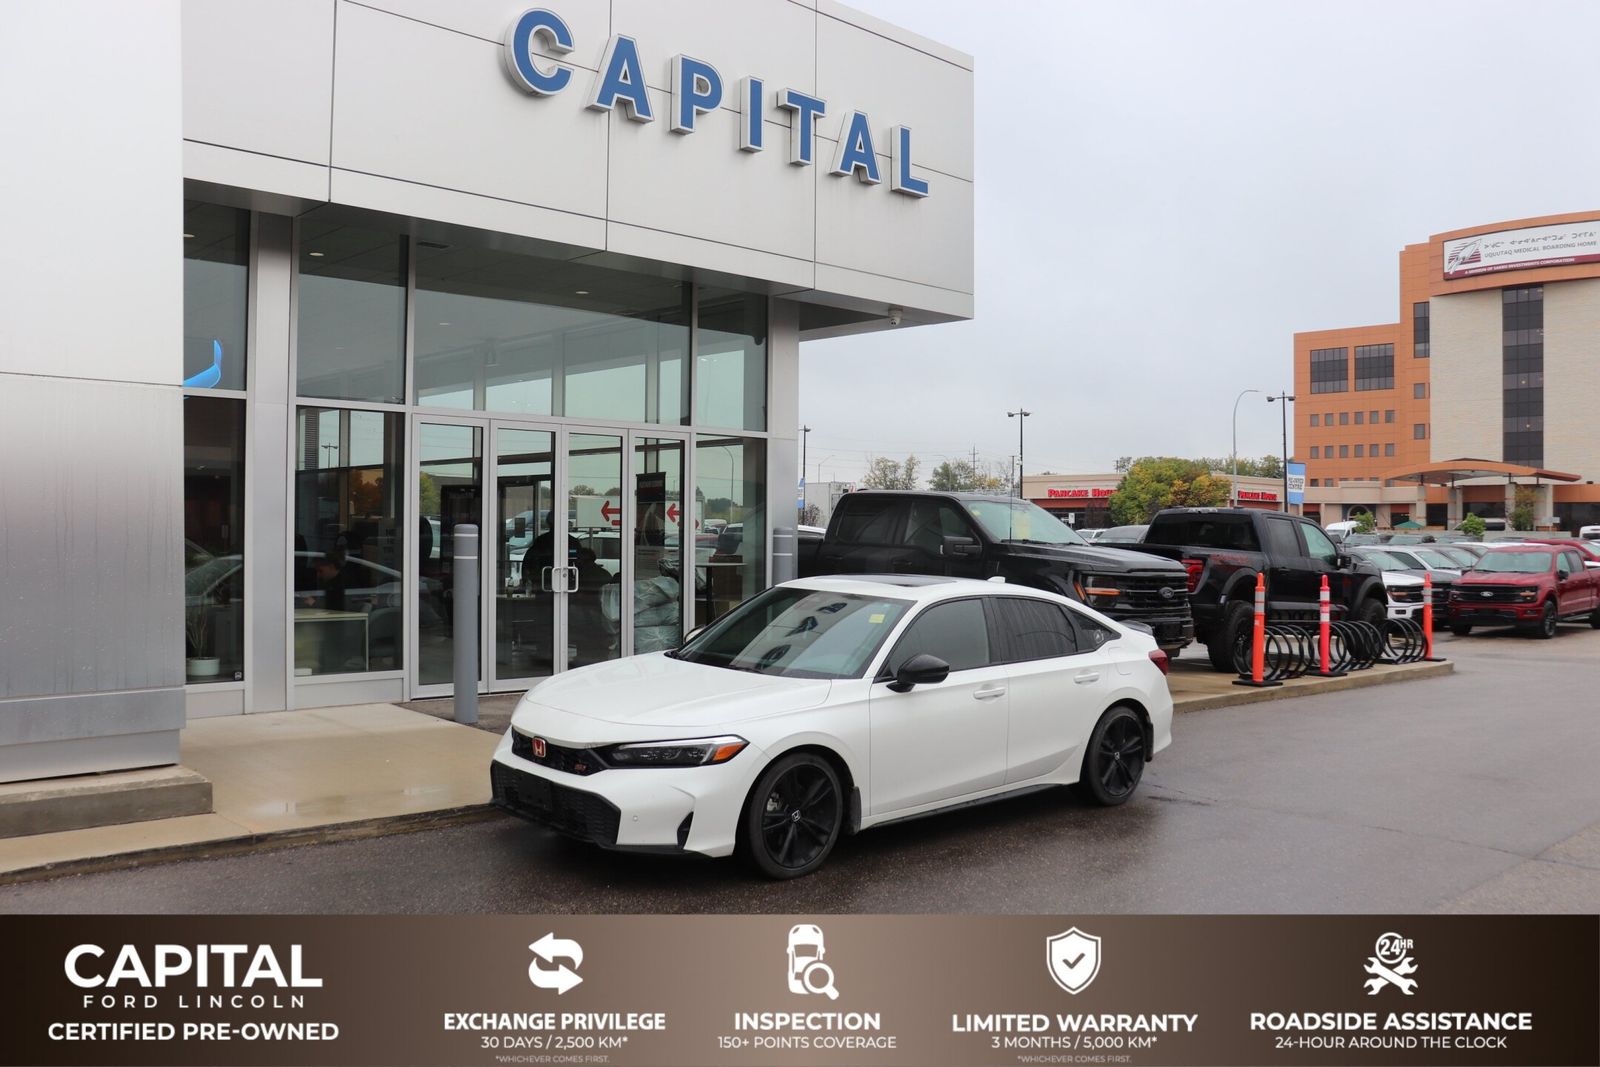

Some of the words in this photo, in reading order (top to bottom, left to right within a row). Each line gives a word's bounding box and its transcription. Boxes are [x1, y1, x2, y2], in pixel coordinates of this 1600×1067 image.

[504, 7, 930, 198] CAPITAL
[1543, 242, 1576, 251] BOARDING
[1577, 240, 1597, 248] HOME
[1048, 488, 1089, 497] PANCAKE
[1092, 488, 1119, 497] HOU
